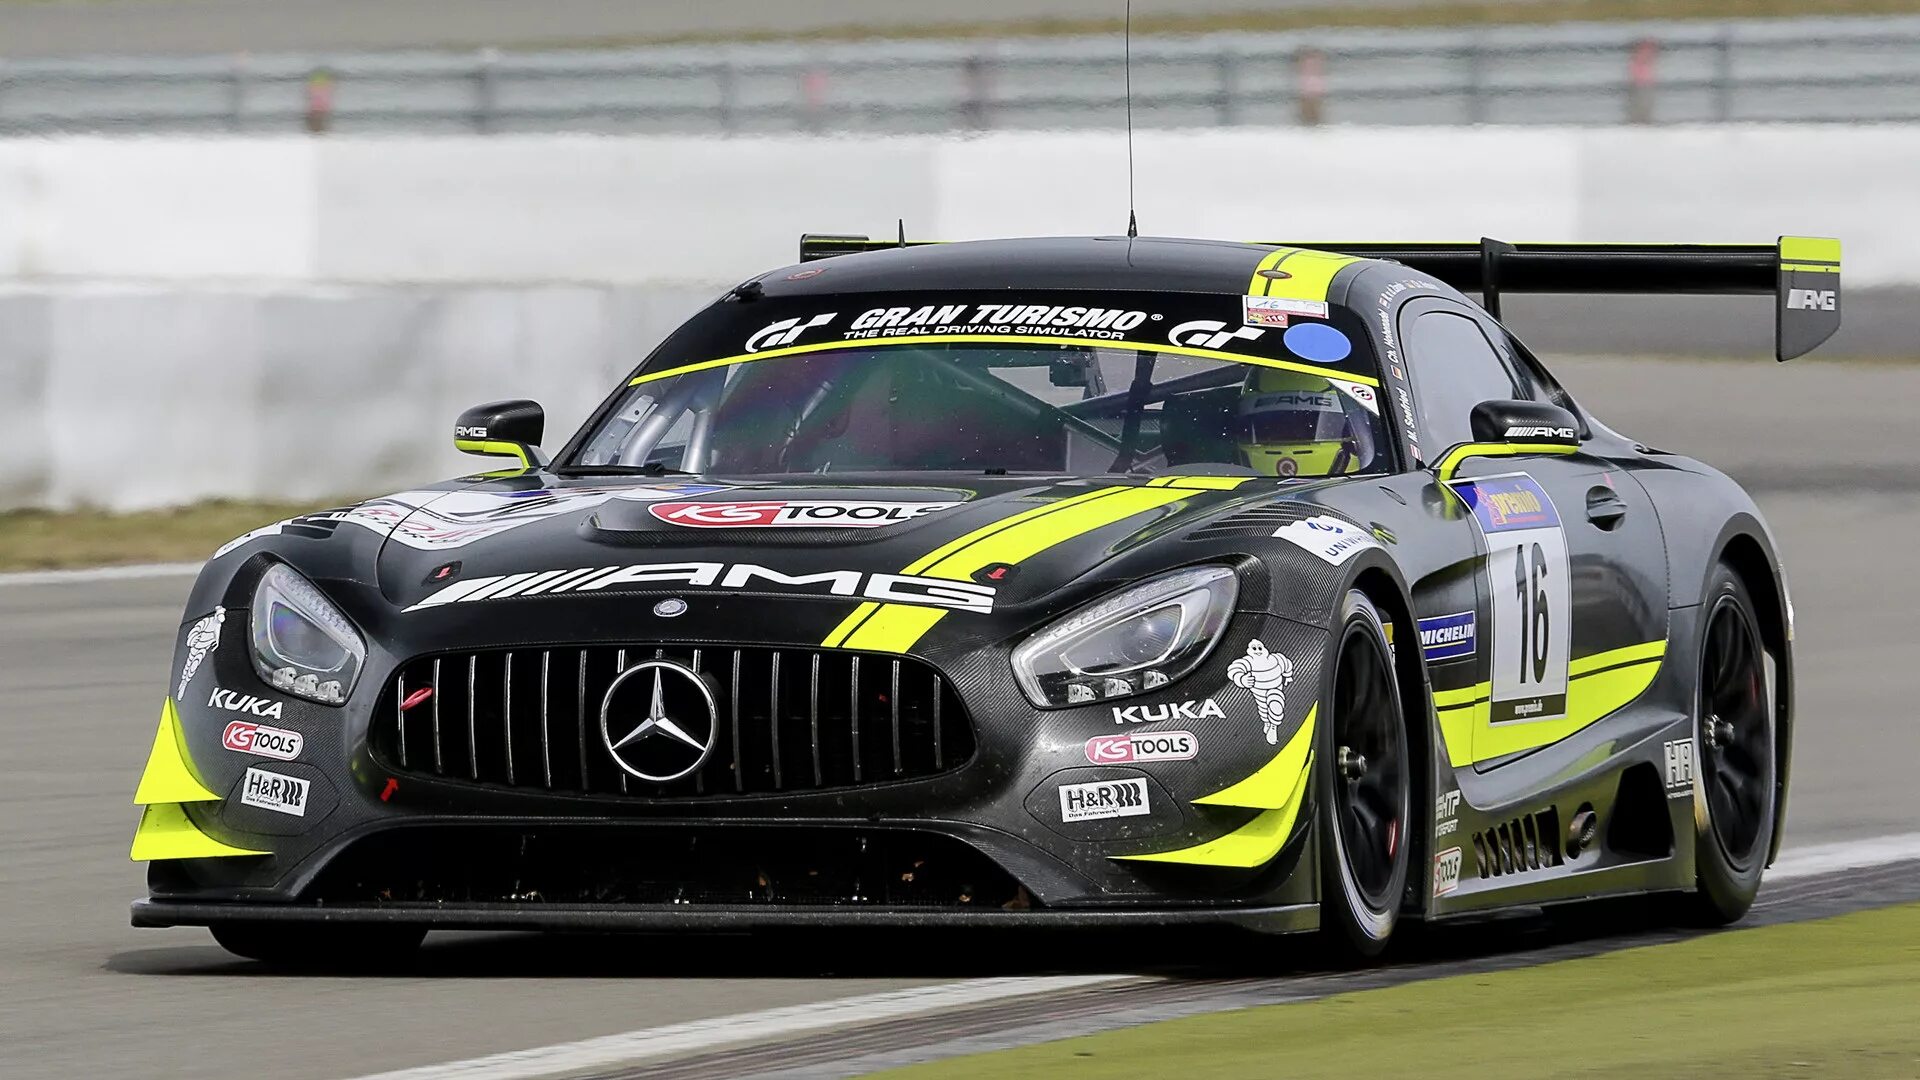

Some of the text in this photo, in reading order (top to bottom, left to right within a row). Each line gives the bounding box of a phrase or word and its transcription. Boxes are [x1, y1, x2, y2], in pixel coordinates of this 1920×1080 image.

[1801, 289, 1836, 311] AMG
[851, 304, 1147, 331] GRAN TURISMO
[844, 325, 1125, 341] THE REAL DRIVING SIMULATOR
[1277, 394, 1332, 407] AMG
[455, 426, 488, 438] AMG
[1530, 426, 1574, 438] AMG
[667, 504, 783, 522] KS
[577, 561, 996, 614] AMG
[1514, 541, 1550, 685] 16
[1419, 622, 1475, 646] MICHELIN
[207, 687, 283, 720] KUKA
[1111, 698, 1227, 725] KUKA
[226, 726, 296, 754] KS TOOLS
[1094, 737, 1189, 760] KS TOOLS
[248, 772, 281, 799] H&R
[1067, 786, 1114, 810] H&R
